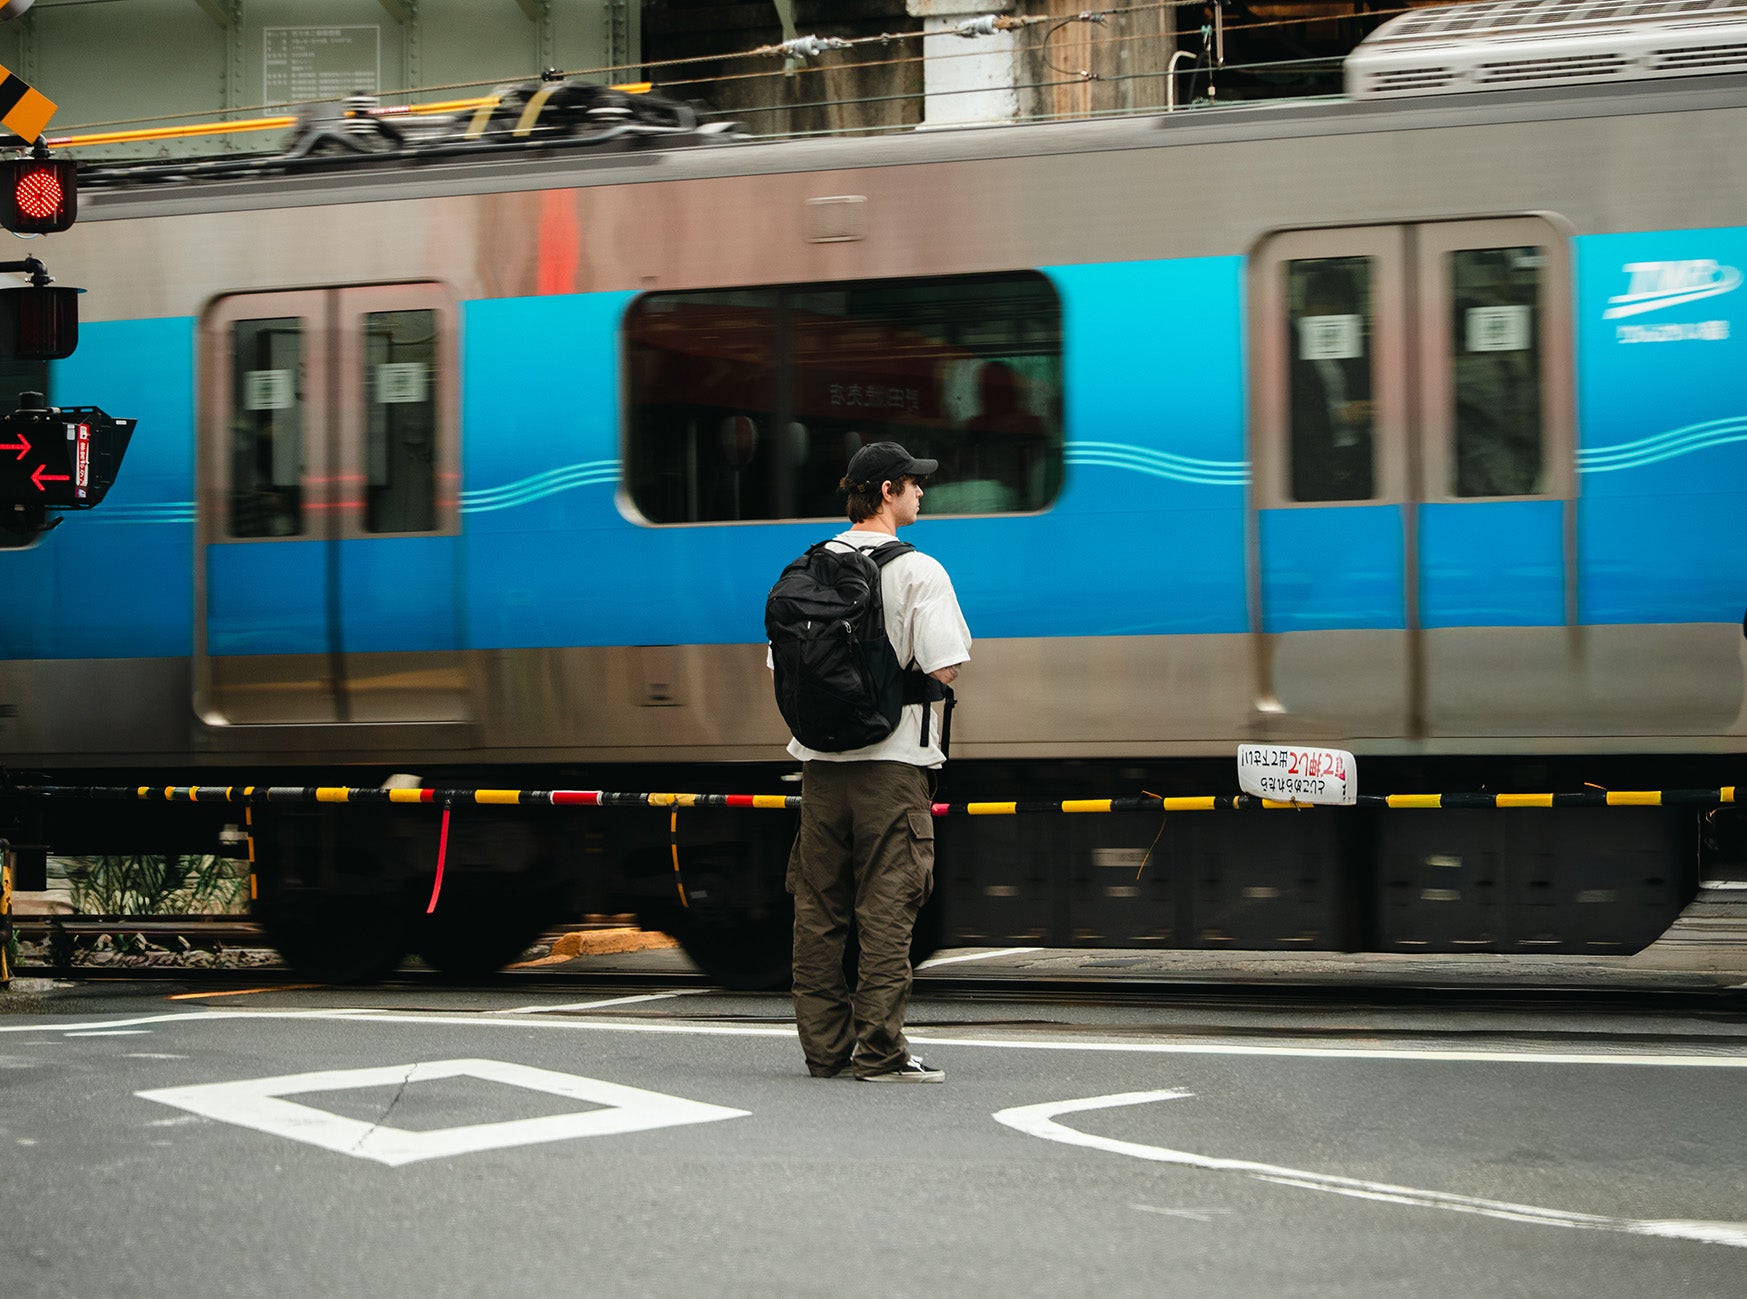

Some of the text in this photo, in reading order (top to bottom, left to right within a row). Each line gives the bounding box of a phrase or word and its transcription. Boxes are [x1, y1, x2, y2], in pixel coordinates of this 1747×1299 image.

[1260, 777, 1326, 794] とじこめられたら
